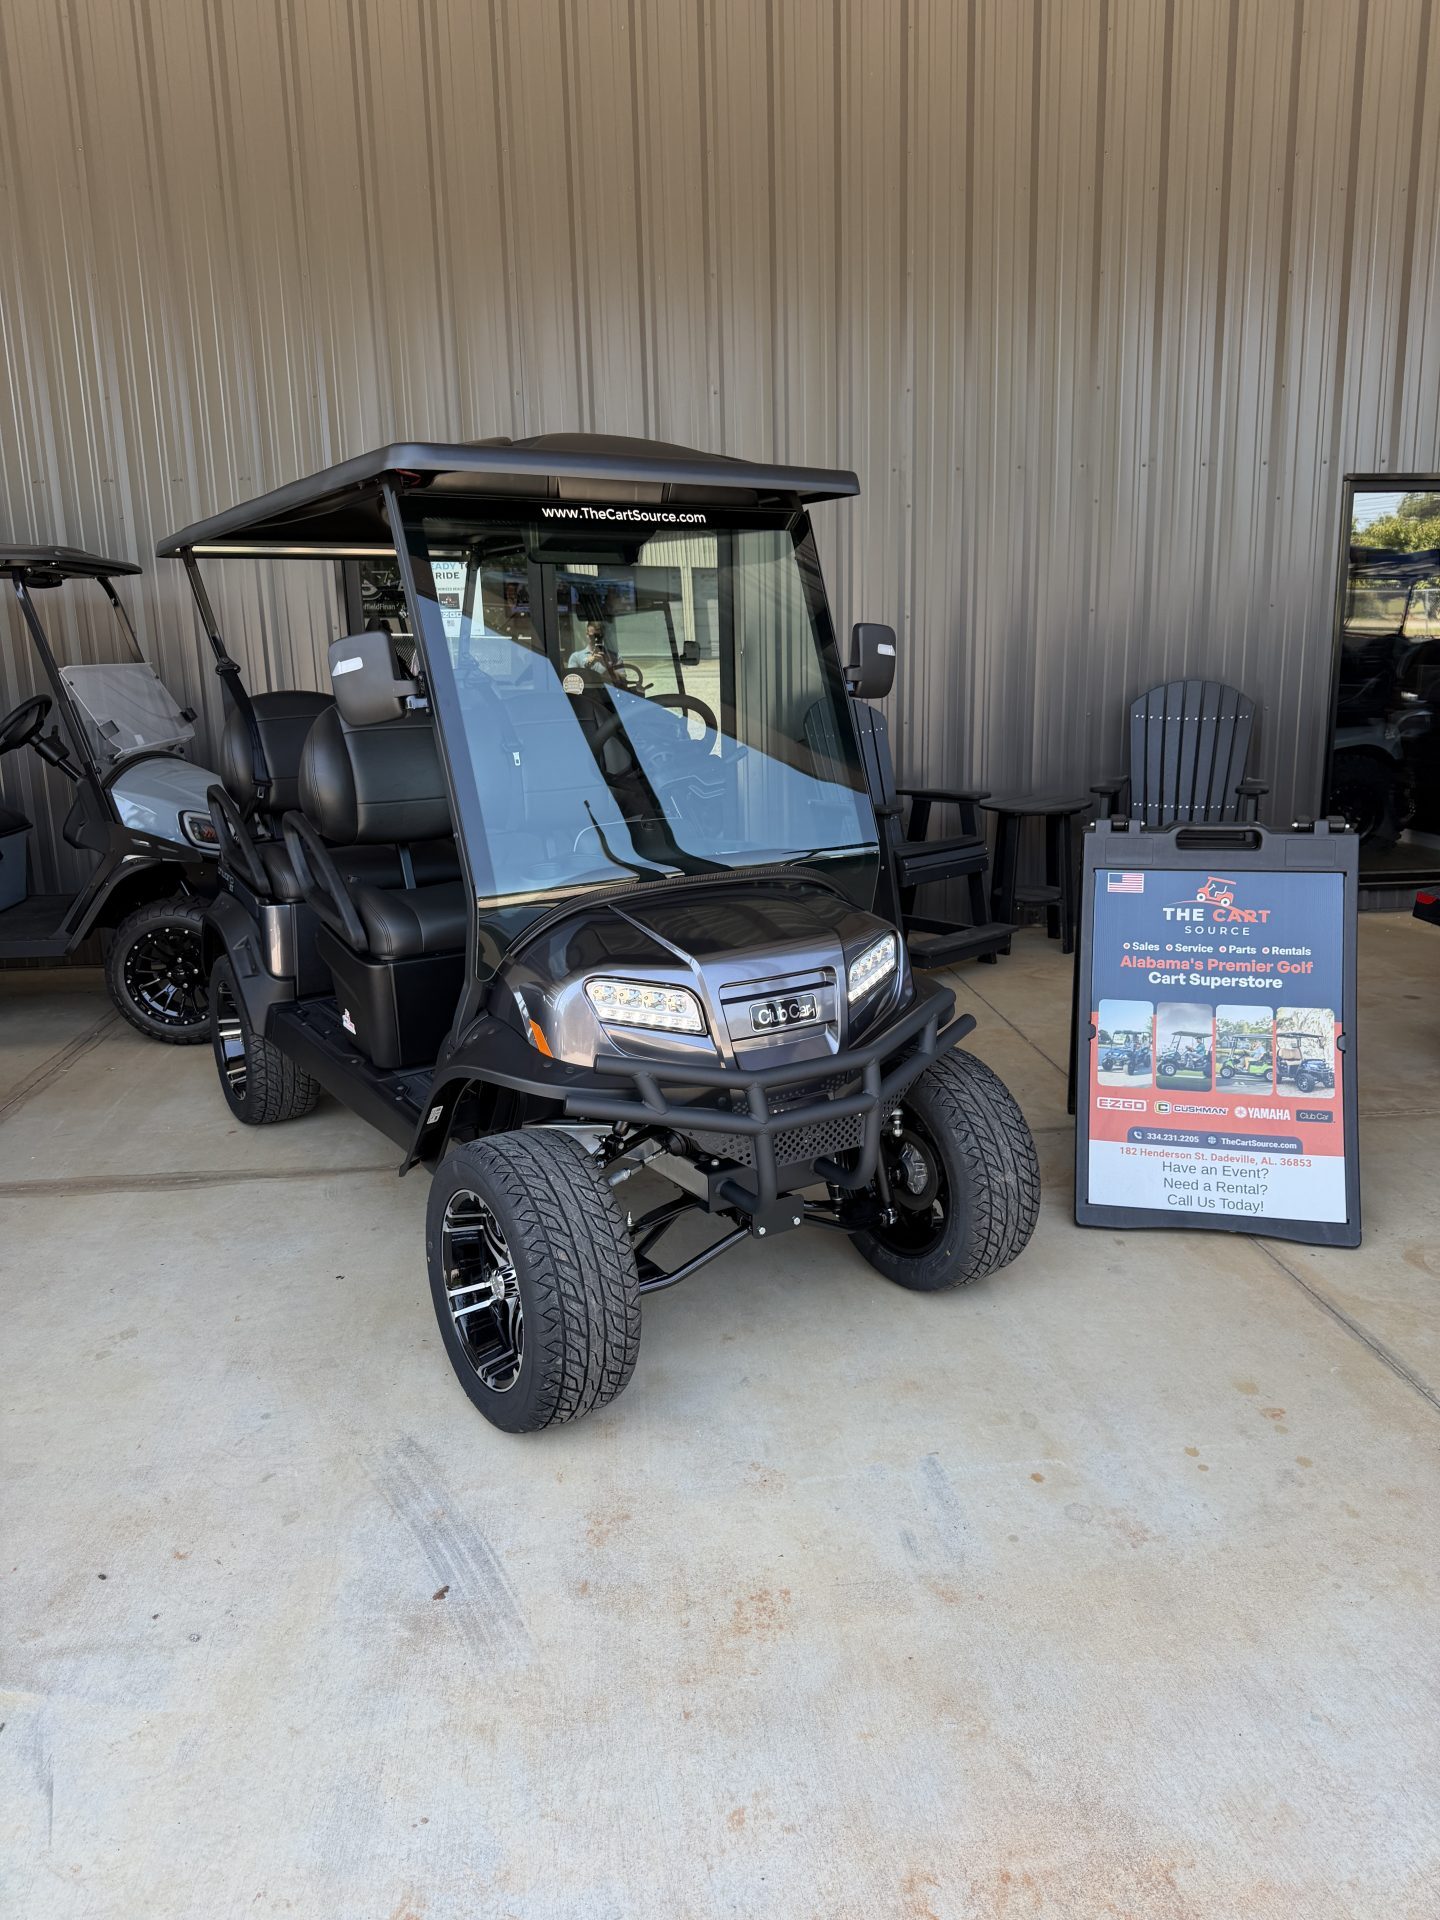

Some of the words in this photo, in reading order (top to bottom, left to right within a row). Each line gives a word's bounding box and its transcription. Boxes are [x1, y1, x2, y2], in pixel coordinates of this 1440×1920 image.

[541, 507, 707, 523] www.TheCartSource.com
[435, 571, 460, 579] RIDE
[1162, 907, 1205, 922] THE
[1212, 907, 1271, 923] CART
[1184, 925, 1251, 936] SOURCE
[1132, 941, 1160, 951] Sales
[1174, 943, 1214, 953] Service
[1228, 944, 1257, 955] Parts
[1271, 946, 1312, 956] Rentals
[1120, 954, 1204, 971] Alabama's
[1207, 958, 1274, 973] Premier
[1276, 960, 1314, 974] Golf
[1148, 971, 1187, 985] Cart
[1189, 972, 1284, 989] Superstore
[758, 1006, 788, 1025] Club
[1173, 1104, 1227, 1115] CUSHMAN
[1247, 1107, 1291, 1121] YAMAHA
[1146, 1132, 1200, 1143] 334.231.2205
[1220, 1137, 1297, 1149] TheCartSource.com
[1120, 1146, 1137, 1156] 182
[1139, 1148, 1192, 1159] Henderson
[1194, 1151, 1208, 1161] St.
[1210, 1153, 1258, 1165] Dadeville,
[1280, 1157, 1312, 1168] 36853
[1162, 1160, 1197, 1174] Have
[1200, 1165, 1218, 1175] an
[1222, 1165, 1270, 1179] Event?
[1163, 1177, 1199, 1191] Need
[1203, 1182, 1212, 1192] a
[1216, 1181, 1269, 1196] Rental?
[1167, 1193, 1193, 1207] Call
[1197, 1195, 1216, 1209] Us
[1218, 1197, 1265, 1214] Today!
